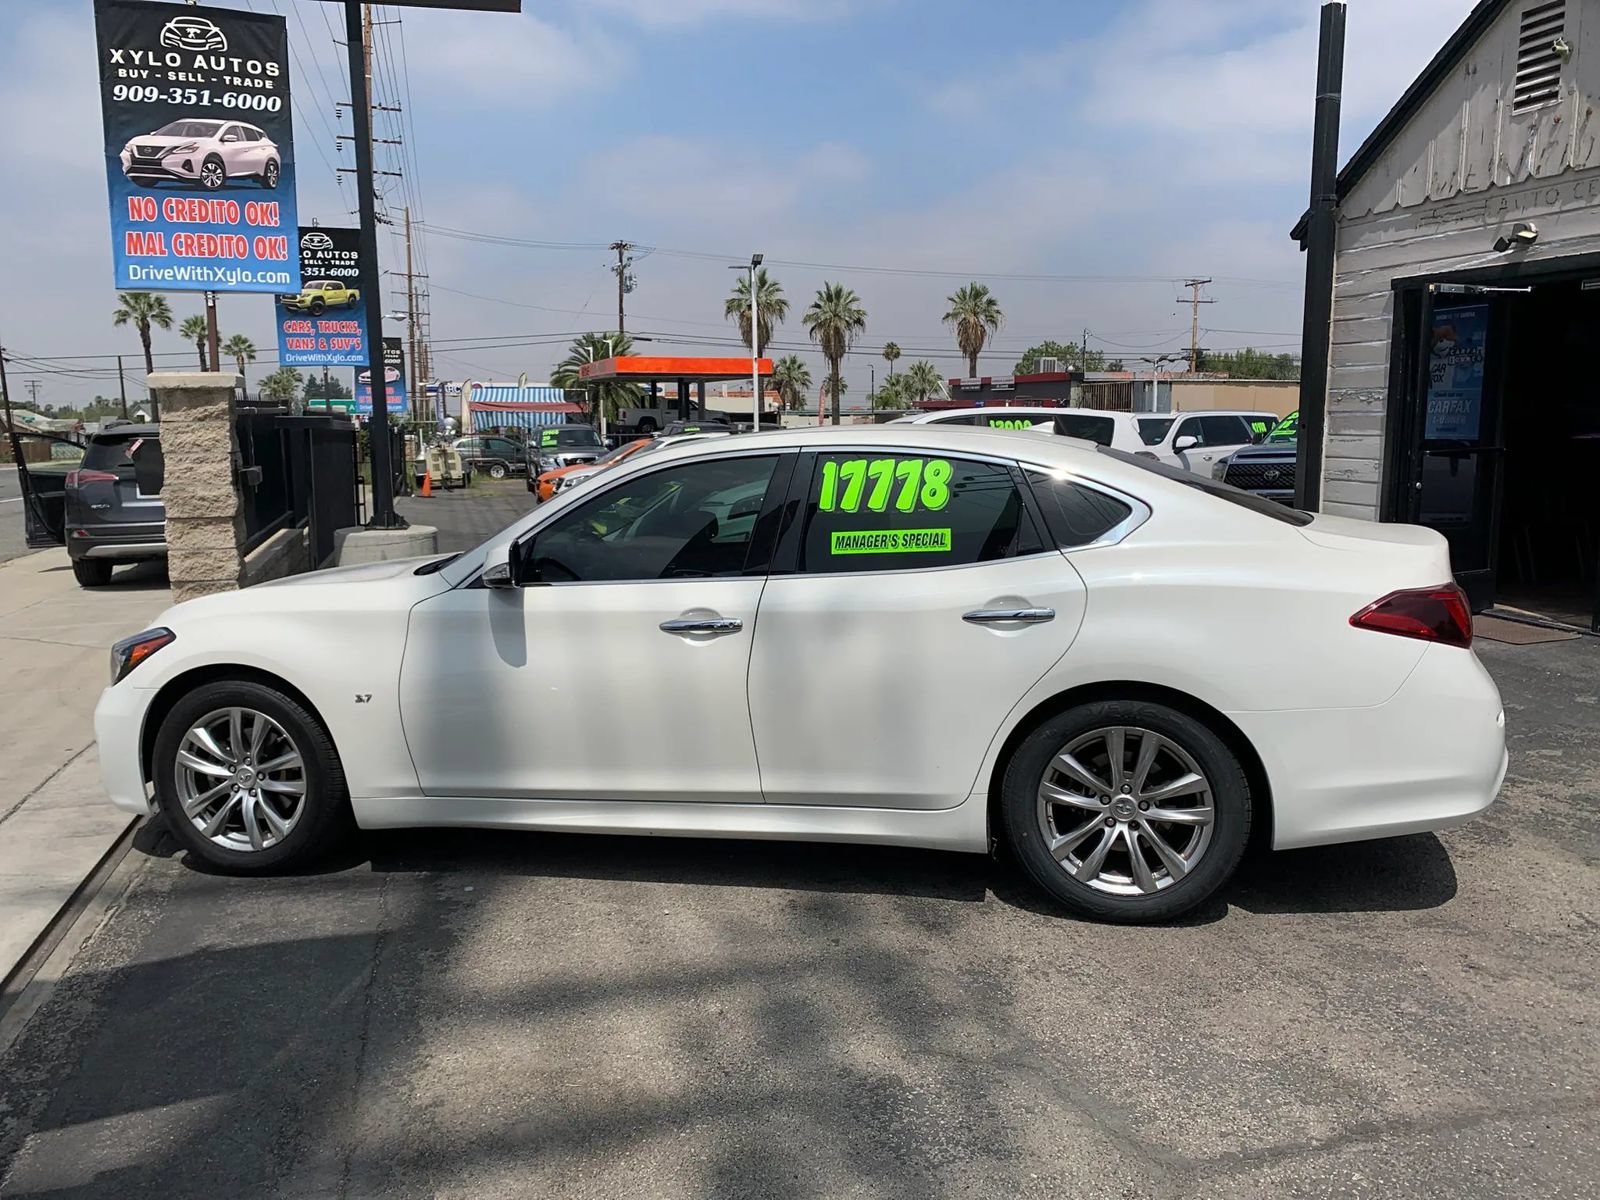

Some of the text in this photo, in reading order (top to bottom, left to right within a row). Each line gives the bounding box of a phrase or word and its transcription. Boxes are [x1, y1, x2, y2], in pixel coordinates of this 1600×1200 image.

[109, 49, 280, 76] XYLO AUTOS
[118, 68, 149, 79] BUY
[167, 71, 205, 83] SELL
[223, 75, 274, 89] TRADE
[113, 85, 282, 112] 909-351-6000
[128, 196, 280, 227] NO CREDITO OK!
[126, 231, 288, 261] MAL CREDITO OK!
[316, 250, 358, 259] AUTOS
[128, 264, 291, 286] DriveWithXylo.com
[300, 267, 359, 277] -351-6000
[283, 320, 362, 336] CARS, TRUCKS,
[286, 337, 362, 351] VANS & SUV'S
[285, 353, 364, 364] DriveWithXylo.com
[1427, 399, 1472, 414] CARFAX
[819, 459, 953, 513] 17778
[835, 532, 946, 550] MANAGER'S SPECIAL
